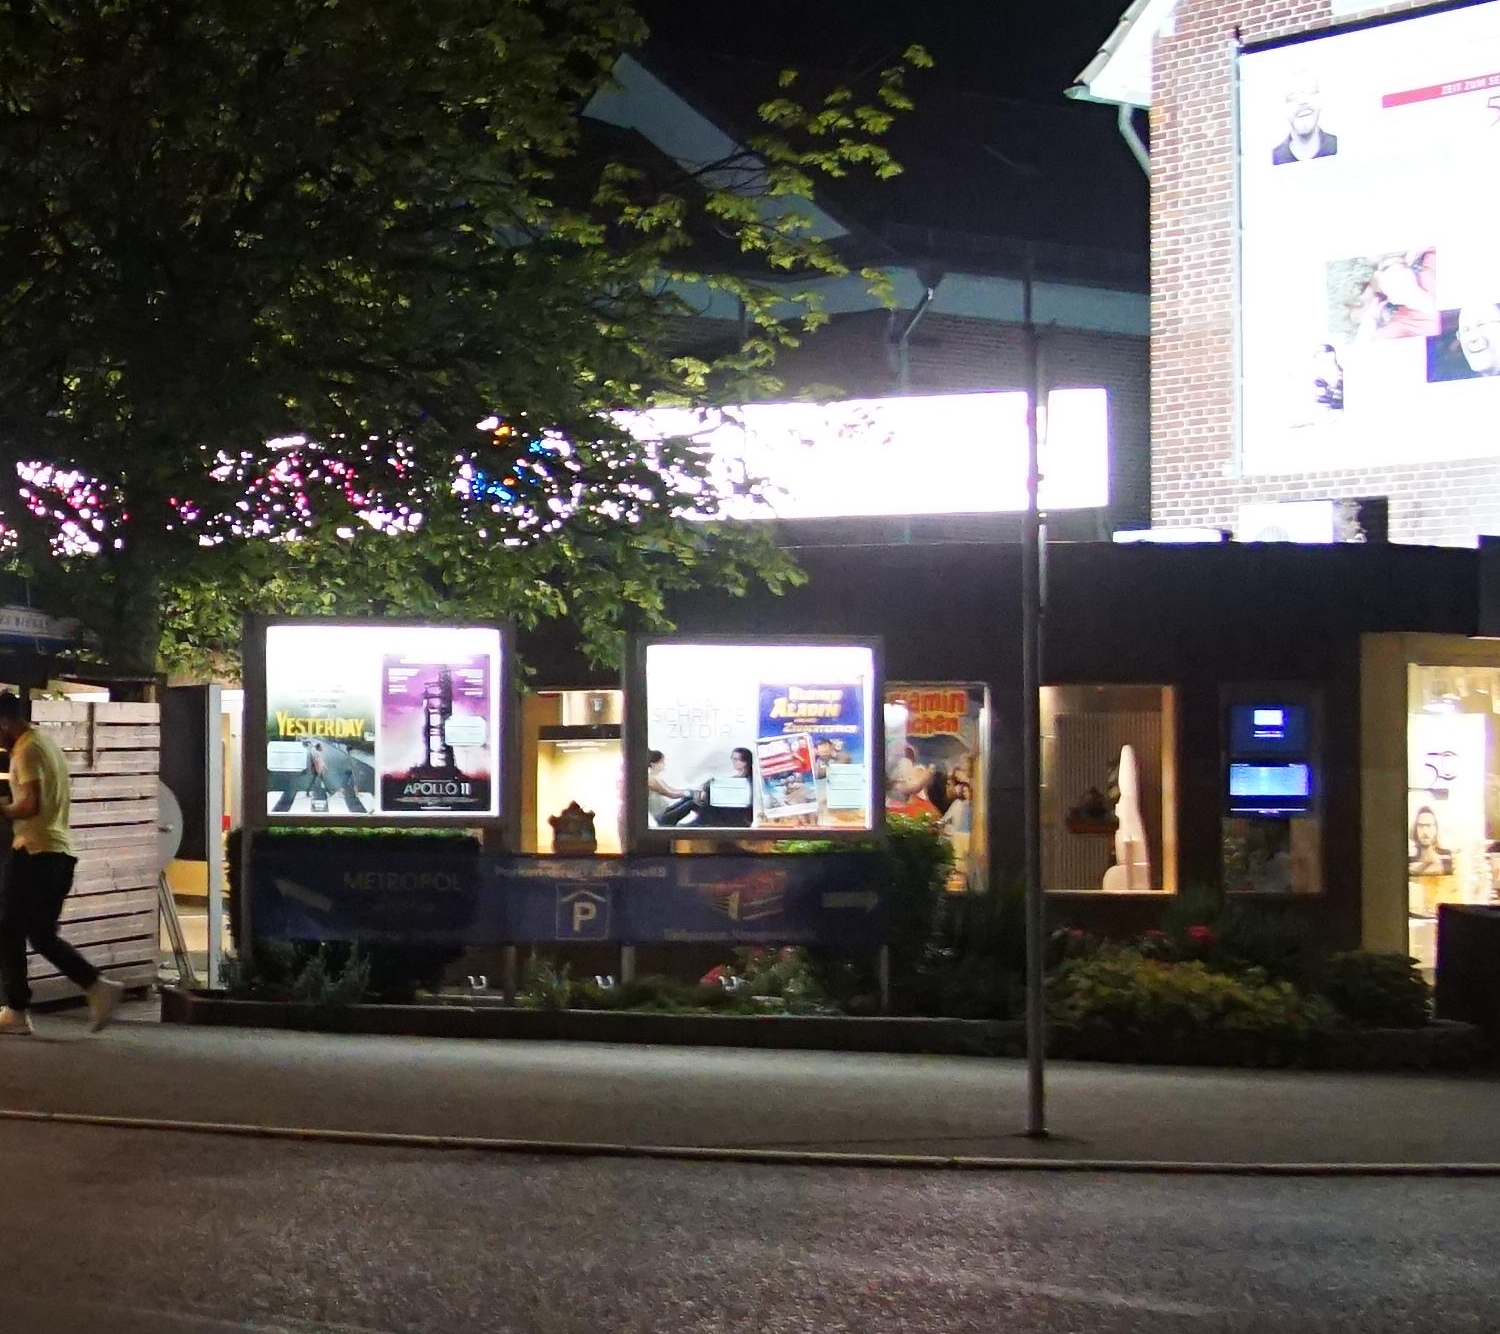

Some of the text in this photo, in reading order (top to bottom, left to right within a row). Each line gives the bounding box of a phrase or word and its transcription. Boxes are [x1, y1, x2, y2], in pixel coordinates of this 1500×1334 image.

[275, 710, 365, 738] YESTERDAY
[403, 782, 471, 795] APOLLO 11
[344, 871, 462, 891] METROPOL
[573, 901, 598, 932] P
